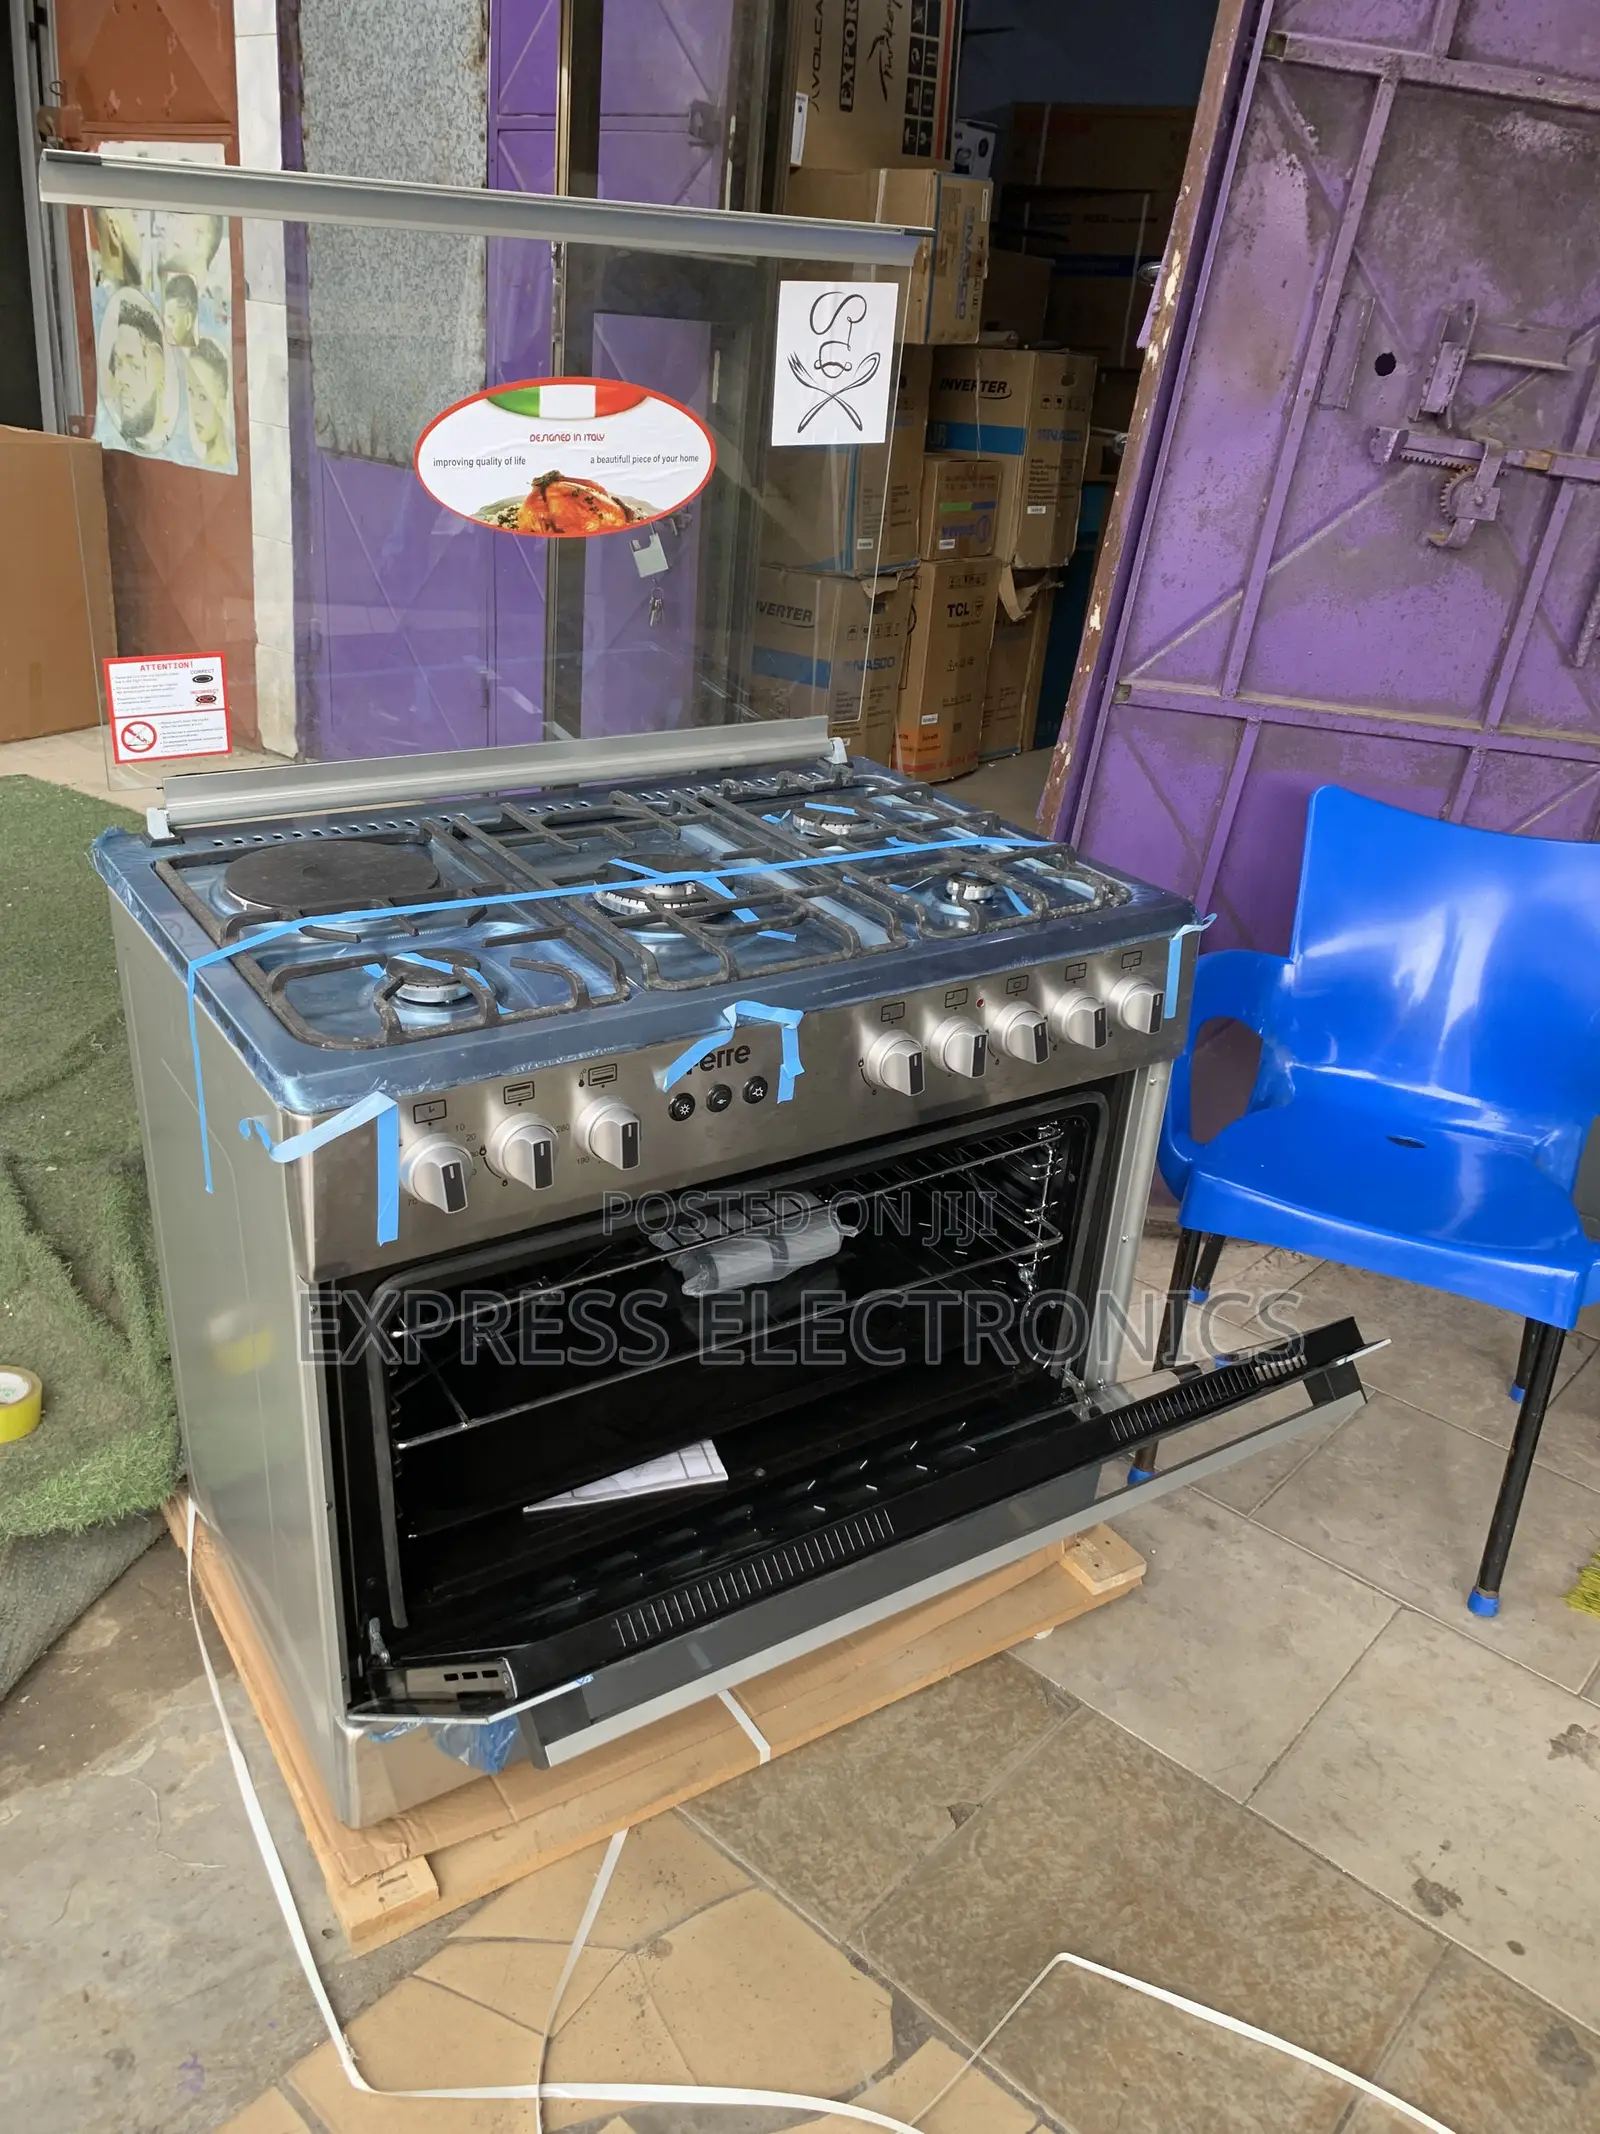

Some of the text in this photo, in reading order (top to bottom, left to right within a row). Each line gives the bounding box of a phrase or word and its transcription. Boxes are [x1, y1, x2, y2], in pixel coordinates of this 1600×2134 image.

[529, 433, 606, 442] DESIGNED IN ITALY
[433, 456, 526, 468] improving quality of life
[590, 454, 699, 465] a beautifull piece of your home
[756, 599, 814, 623] VERTER
[947, 602, 970, 618] TCL
[140, 661, 194, 672] ATTENTION!
[456, 1123, 466, 1132] 10
[466, 1132, 477, 1142] 20
